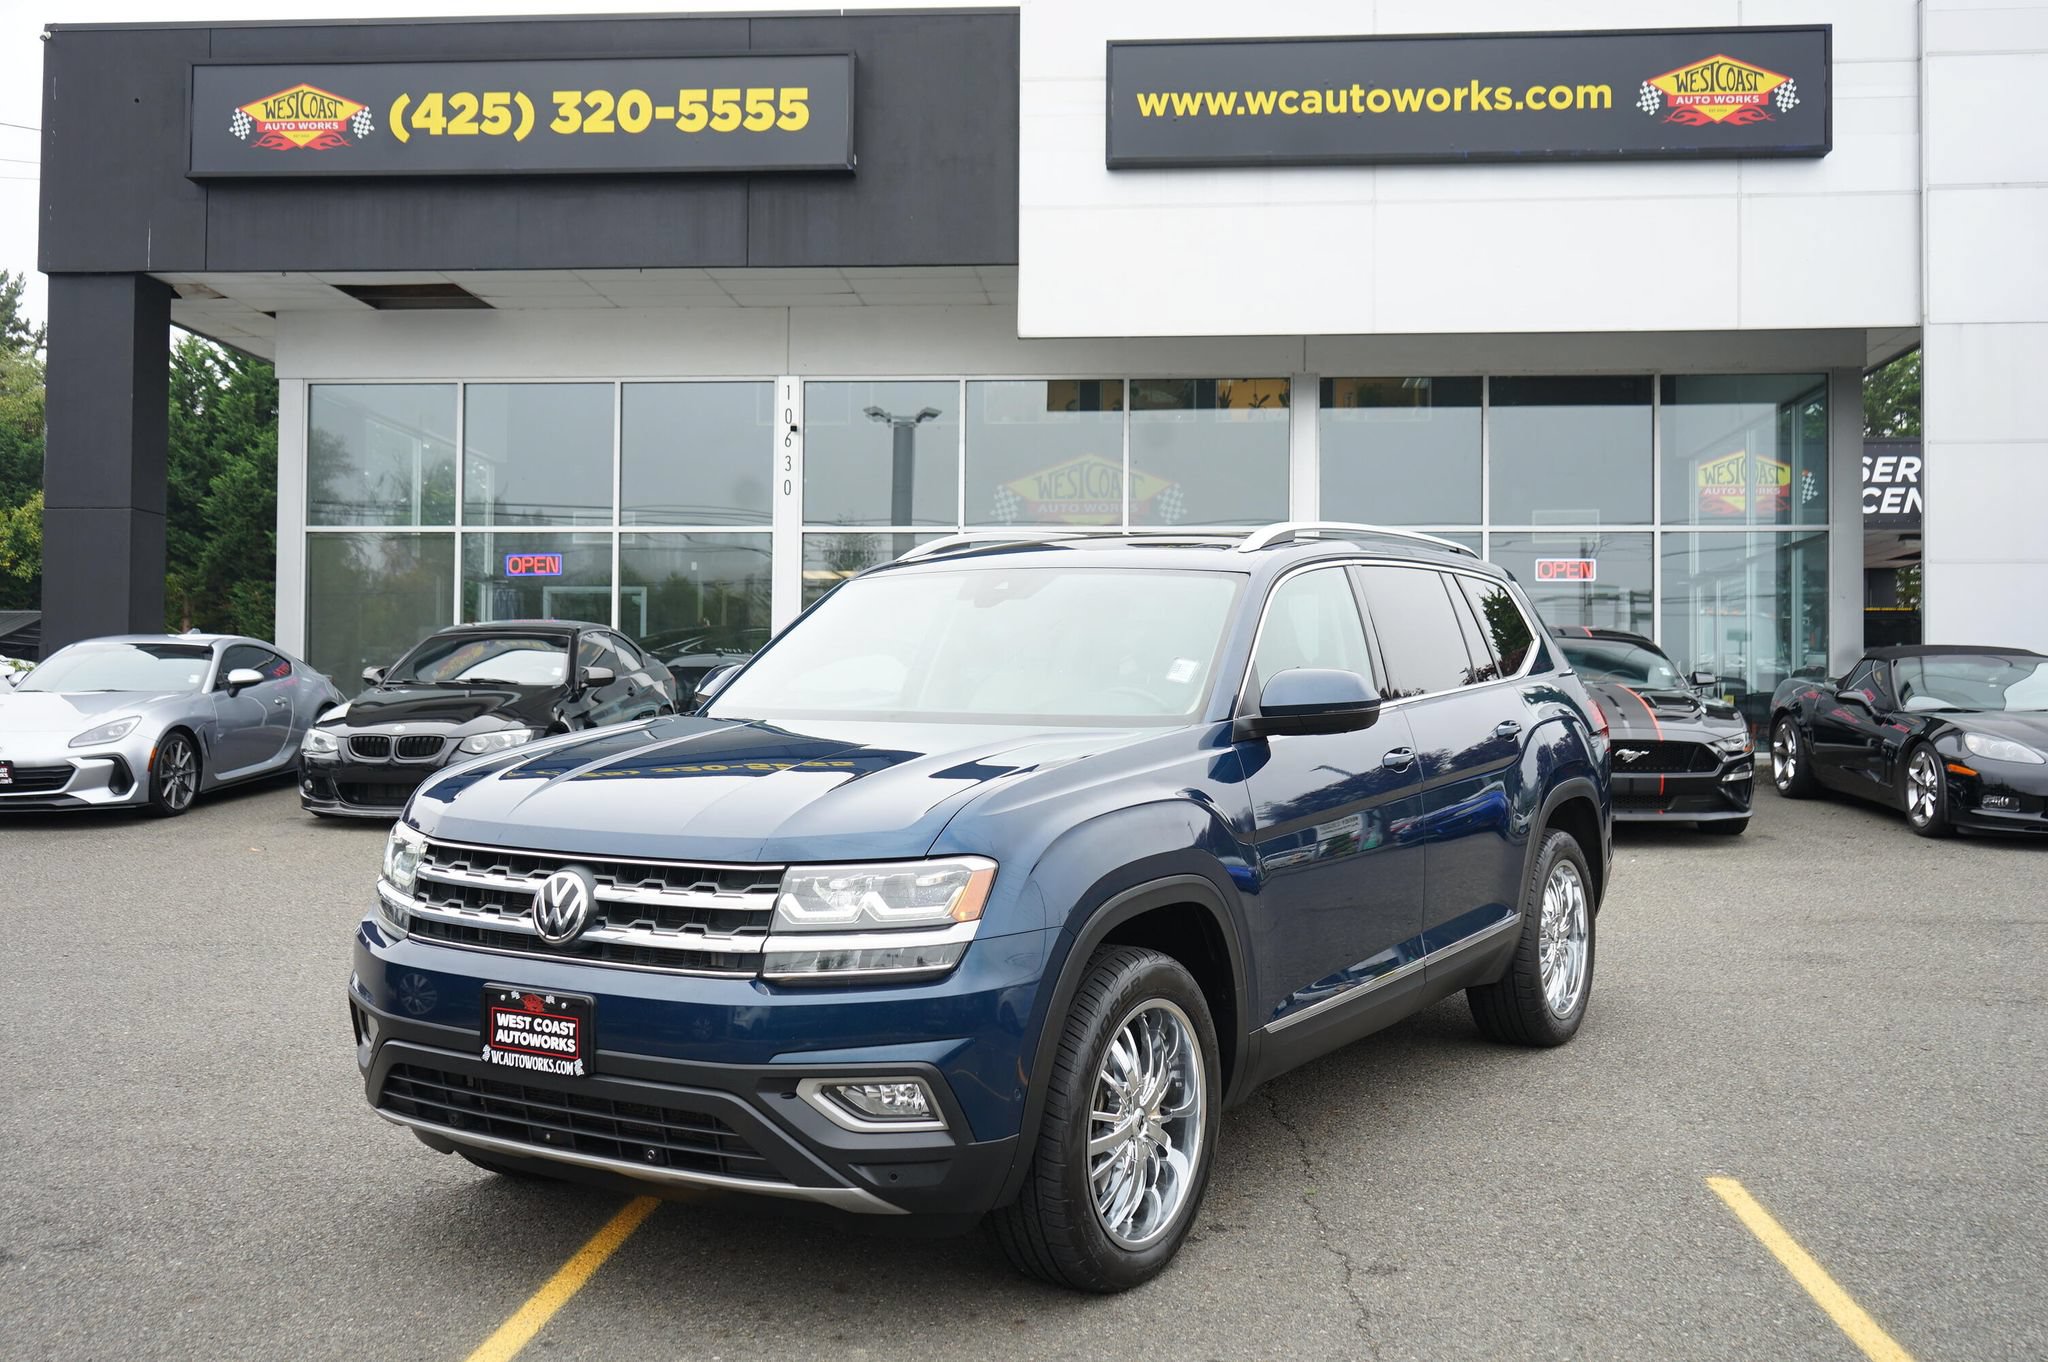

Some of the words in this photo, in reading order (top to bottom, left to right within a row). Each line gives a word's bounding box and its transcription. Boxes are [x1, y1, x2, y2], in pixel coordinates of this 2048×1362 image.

[1136, 79, 1613, 117] www.wcautoworks.com
[1675, 95, 1711, 105] AUTO
[1714, 95, 1760, 104] WORKS
[264, 121, 297, 131] AUTO
[298, 121, 339, 130] WORKS
[388, 90, 536, 144] (425)
[549, 87, 810, 135] 320-5555
[1033, 460, 1145, 499] WESTCOAT
[1703, 486, 1737, 496] AUTO
[1037, 502, 1080, 513] AUTO
[1082, 502, 1139, 513] WORS
[508, 556, 559, 574] OPEN
[1538, 560, 1594, 579] OPEN
[496, 1012, 532, 1030] WEST
[533, 1017, 576, 1037] COAST
[495, 1029, 577, 1053] AUTOWORKS
[490, 1050, 574, 1076] WCAUTOWORKS.COM
